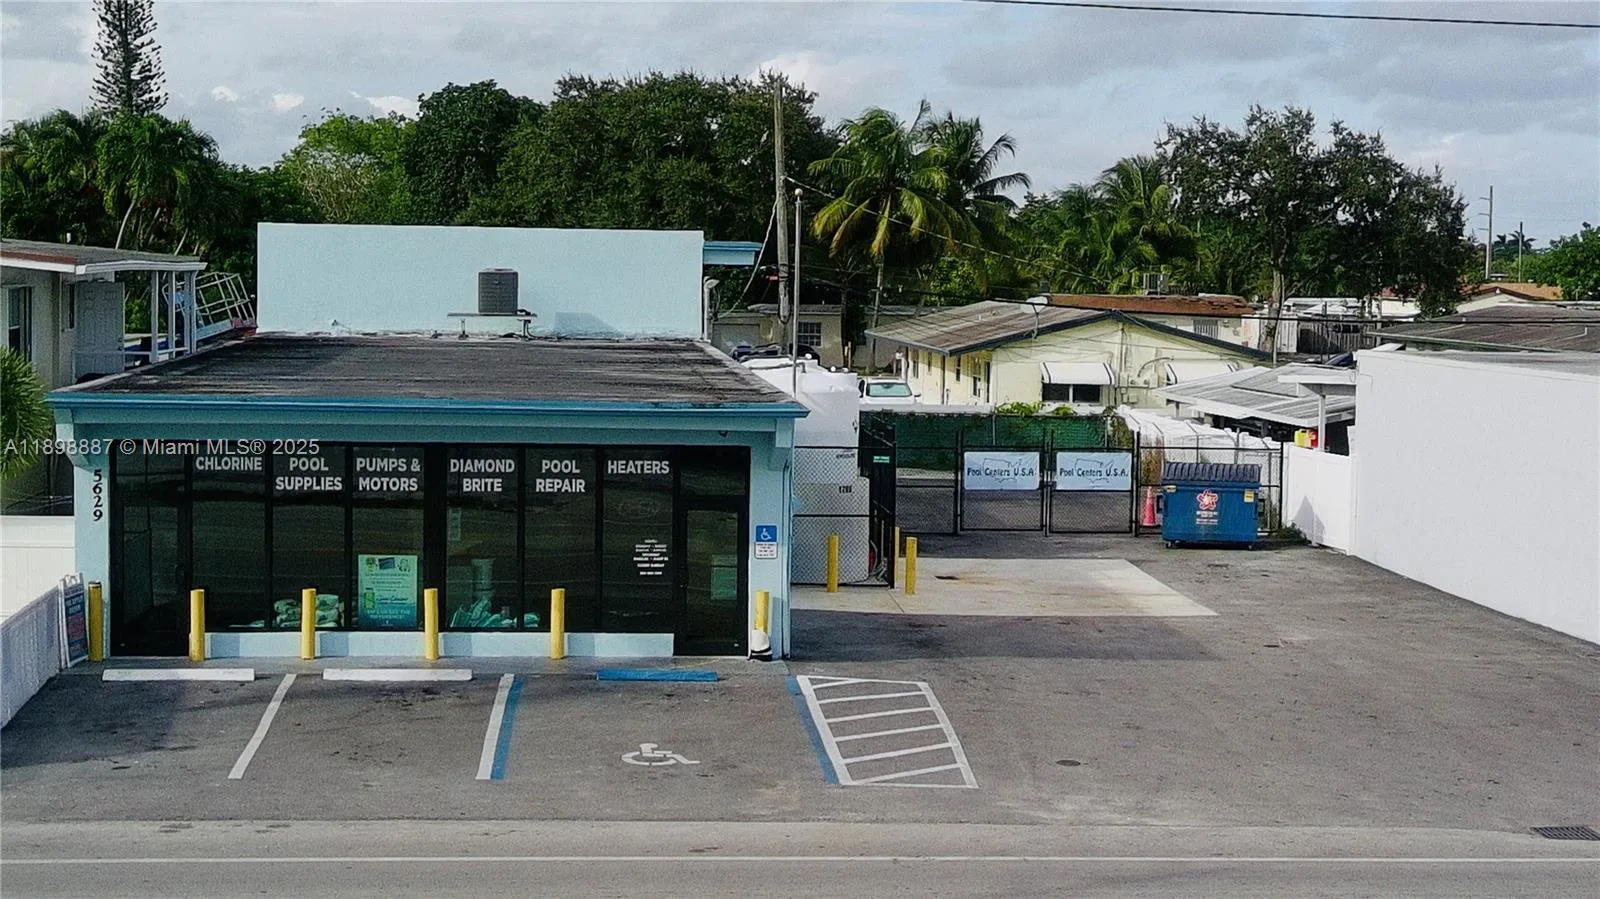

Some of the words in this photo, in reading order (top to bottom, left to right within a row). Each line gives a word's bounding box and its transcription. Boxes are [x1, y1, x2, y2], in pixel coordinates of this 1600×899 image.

[195, 456, 263, 472] CHLORINE
[289, 457, 329, 472] POOL
[356, 457, 407, 472] PUMPS
[410, 458, 421, 472] &
[449, 458, 515, 473] DIAMOND
[541, 459, 580, 473] POOL
[607, 460, 670, 475] HEATERS
[967, 467, 982, 476] Pool
[1059, 467, 1074, 476] Pool
[275, 476, 343, 491] SUPPLIES
[358, 477, 418, 492] MOTORS
[462, 478, 503, 493] BRITE
[535, 478, 586, 493] REPAIR
